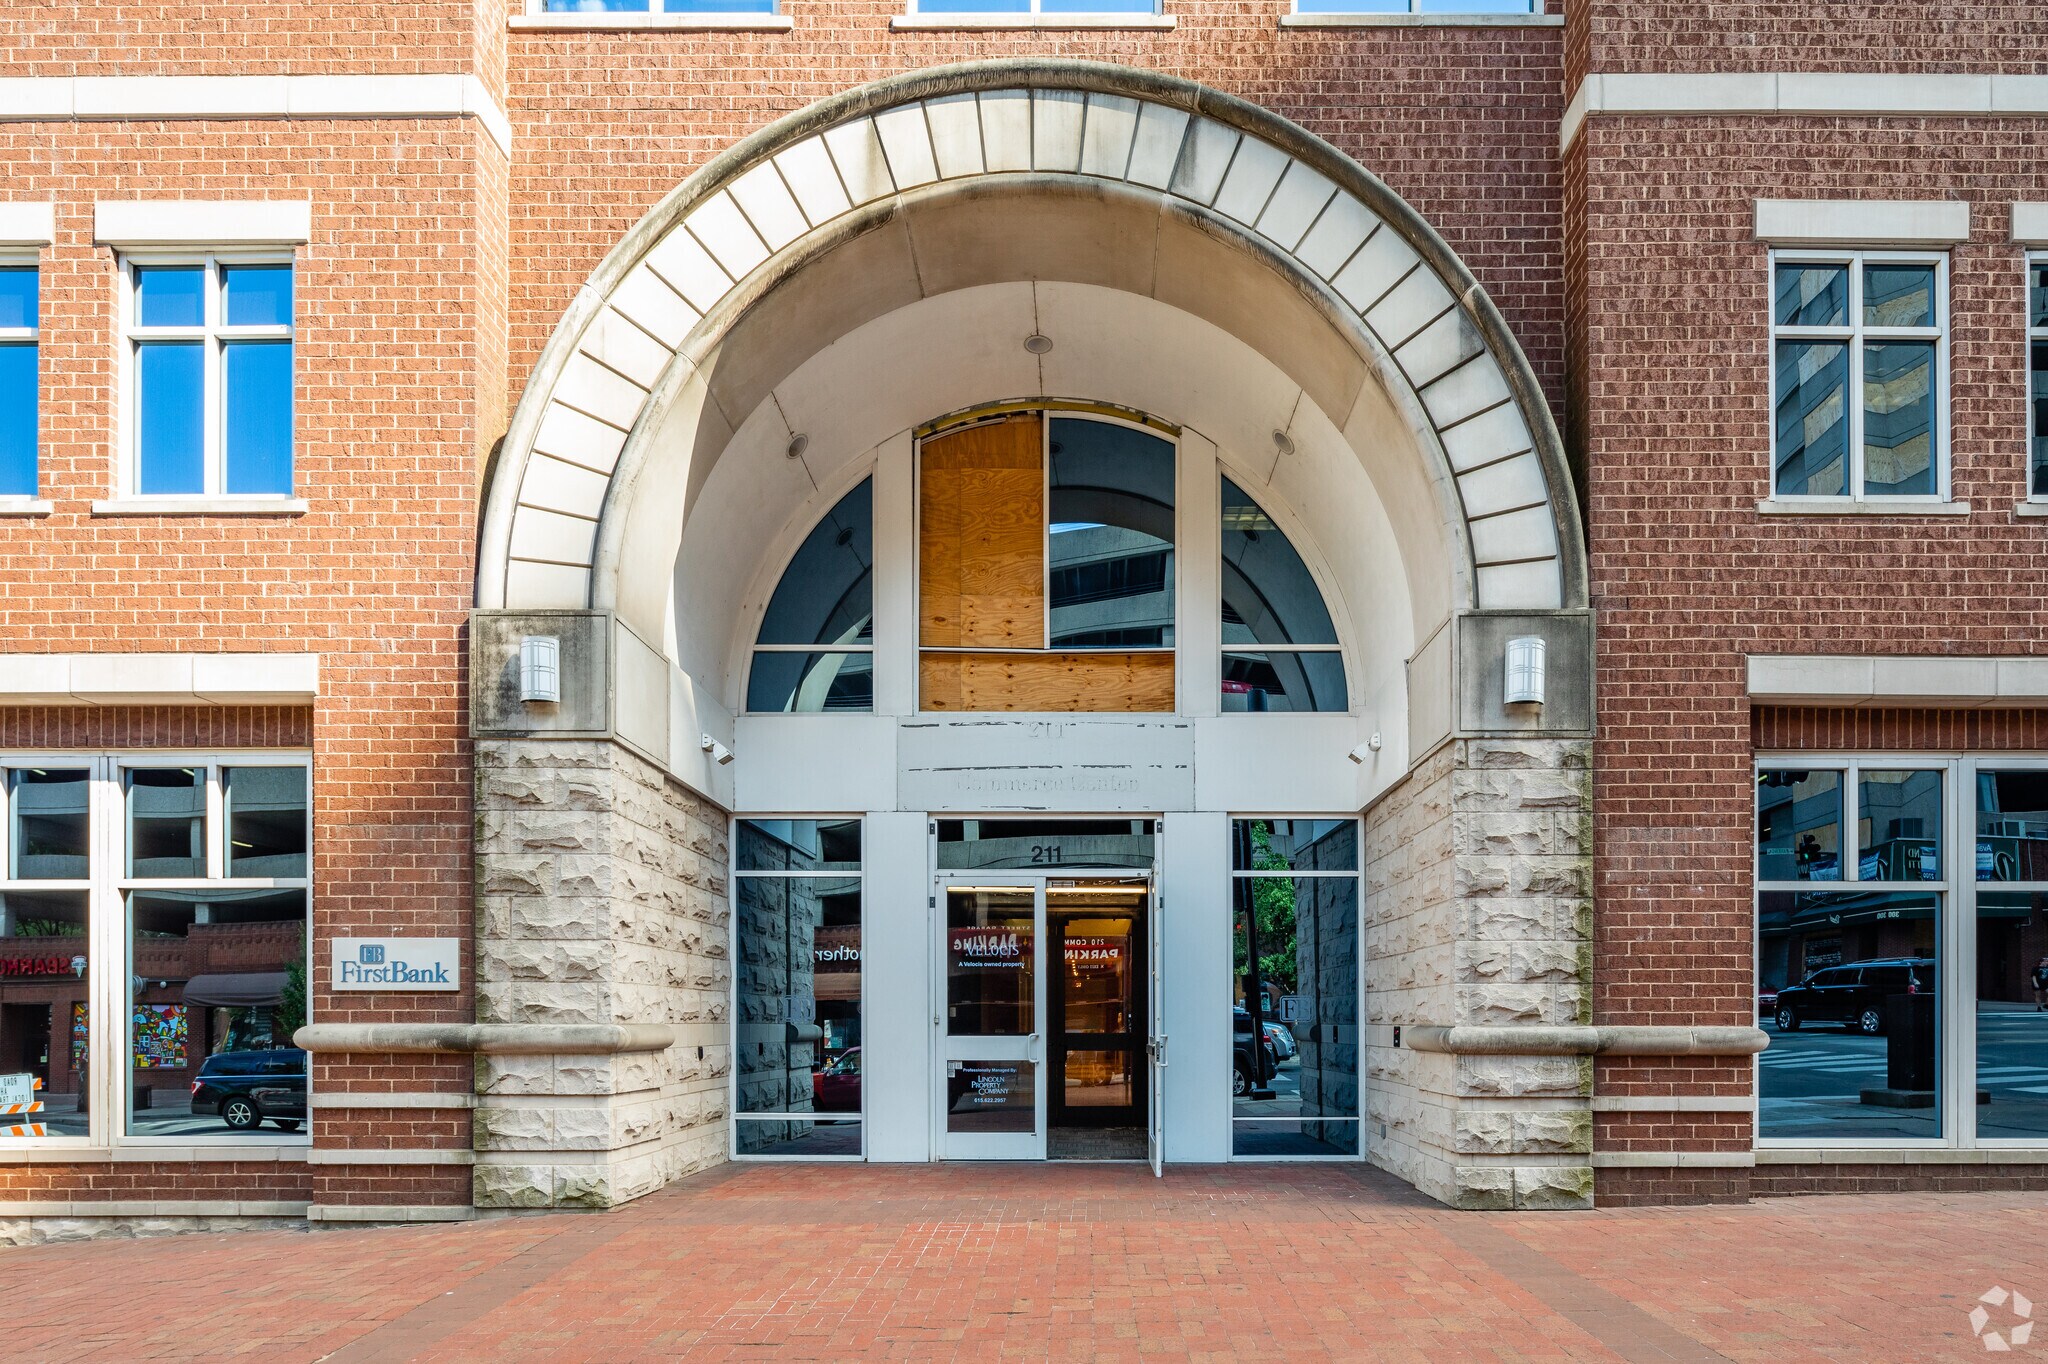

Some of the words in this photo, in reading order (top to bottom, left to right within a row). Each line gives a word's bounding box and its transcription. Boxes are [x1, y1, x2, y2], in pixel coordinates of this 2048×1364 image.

[1029, 722, 1064, 738] 211
[1031, 845, 1062, 863] 211
[965, 944, 1020, 957] VELOCIS
[340, 960, 450, 983] FirstBank
[971, 1081, 1001, 1089] PROPERTY
[977, 1075, 1005, 1083] LINCOLN
[978, 1088, 1009, 1096] COMPANY
